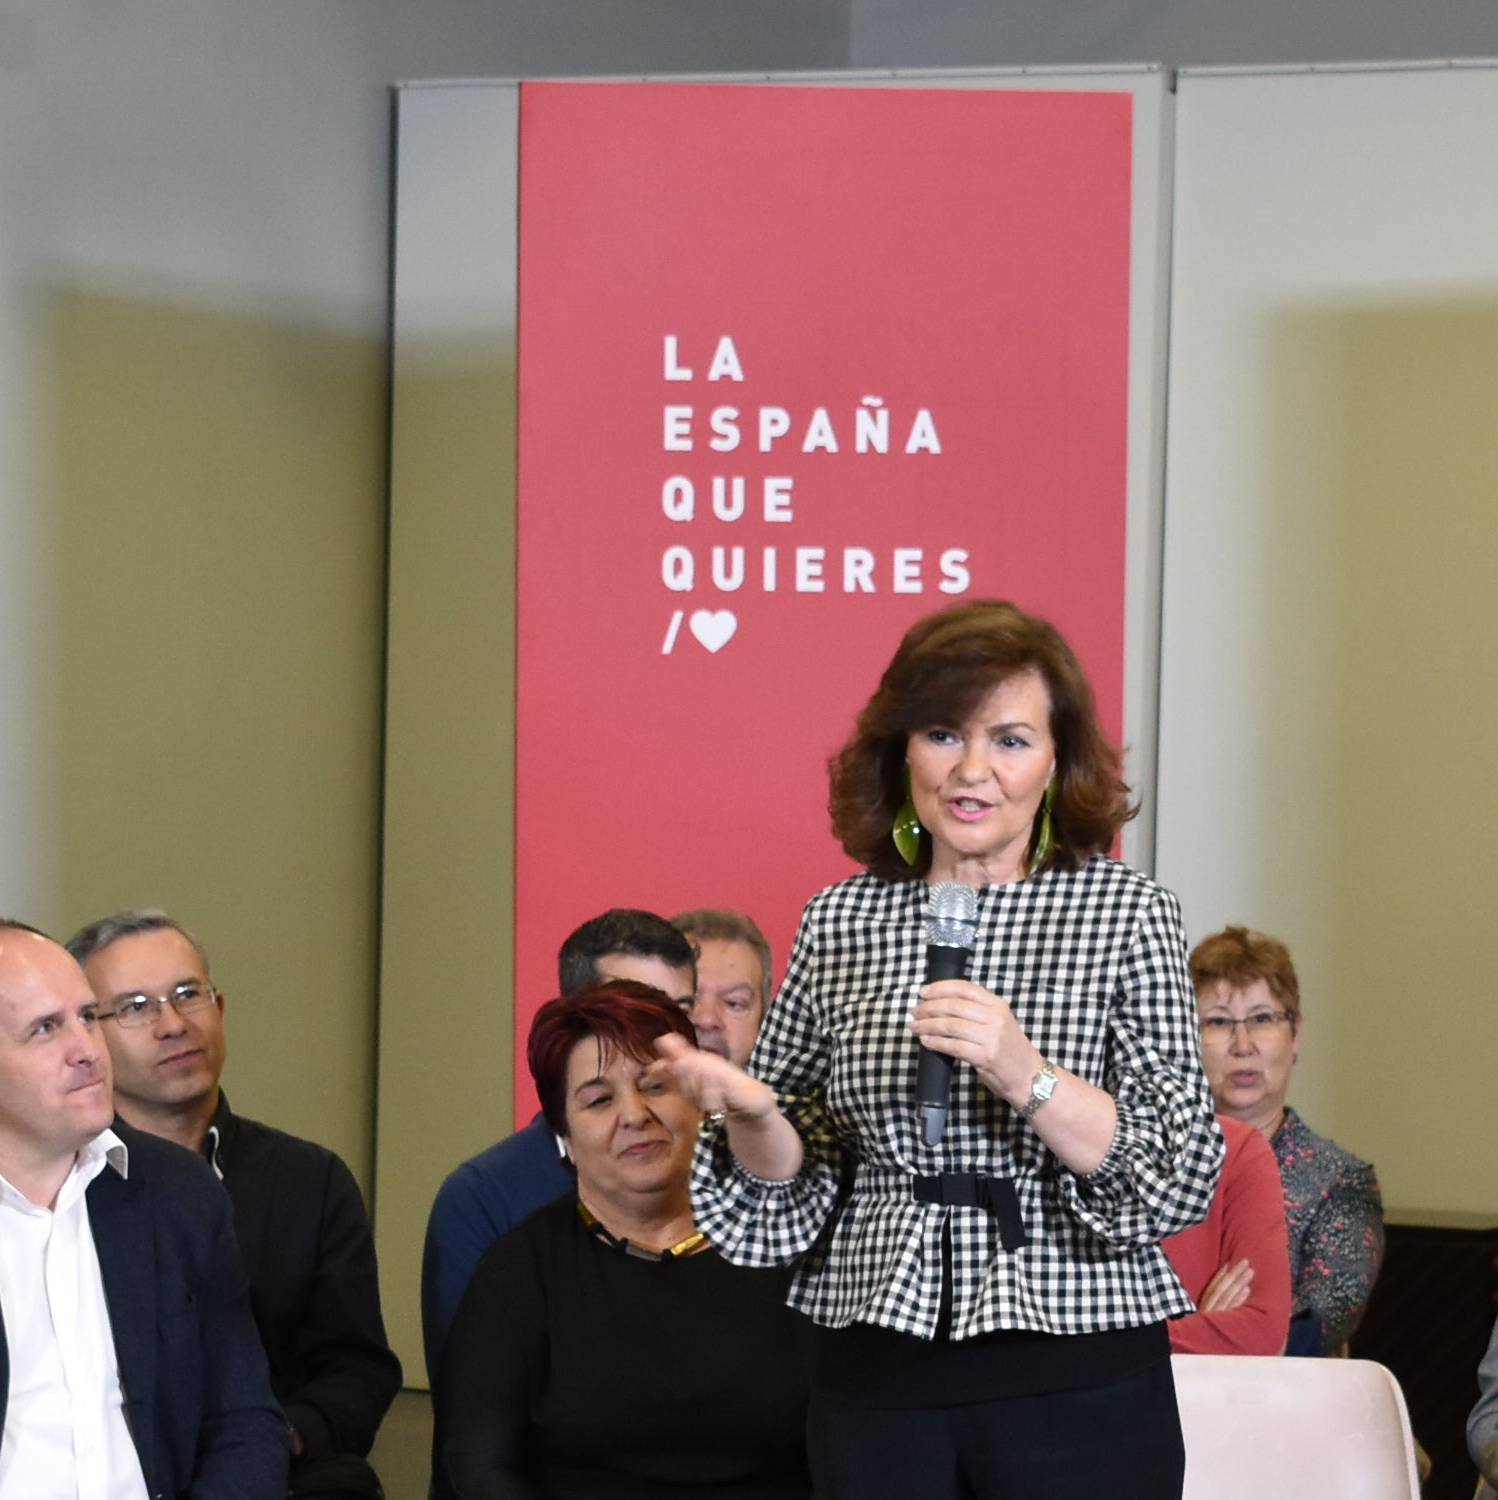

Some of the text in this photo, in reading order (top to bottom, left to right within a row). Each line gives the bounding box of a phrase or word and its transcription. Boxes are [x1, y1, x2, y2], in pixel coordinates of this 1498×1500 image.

[663, 334, 744, 382] LA
[663, 395, 942, 455] ESPAÑA
[661, 475, 794, 523] QUE
[661, 545, 971, 594] QUIERES
